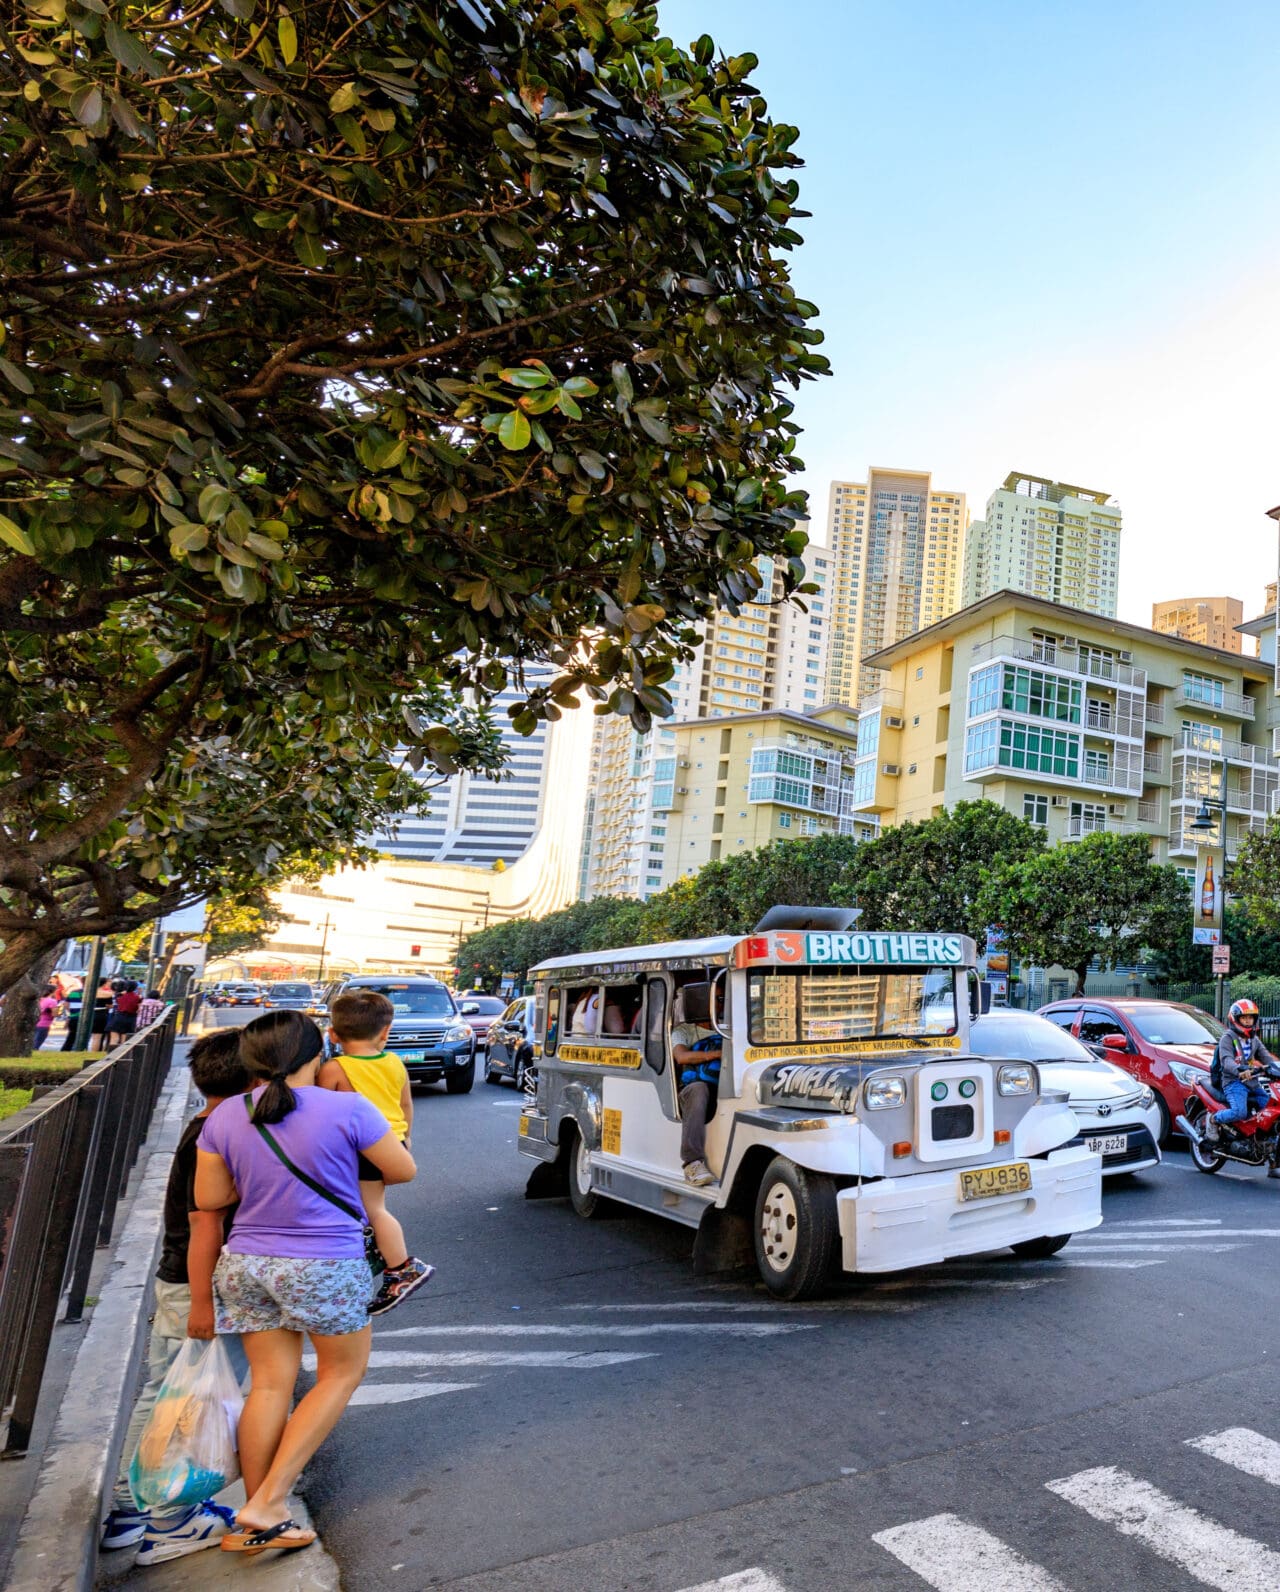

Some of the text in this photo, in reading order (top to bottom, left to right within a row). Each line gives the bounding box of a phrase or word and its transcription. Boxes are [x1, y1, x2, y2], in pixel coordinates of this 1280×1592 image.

[775, 933, 963, 963] 3 BROTHERS
[780, 1046, 808, 1056] HOUSING
[771, 1065, 850, 1099] SIMPLE
[1105, 1138, 1125, 1150] 6228
